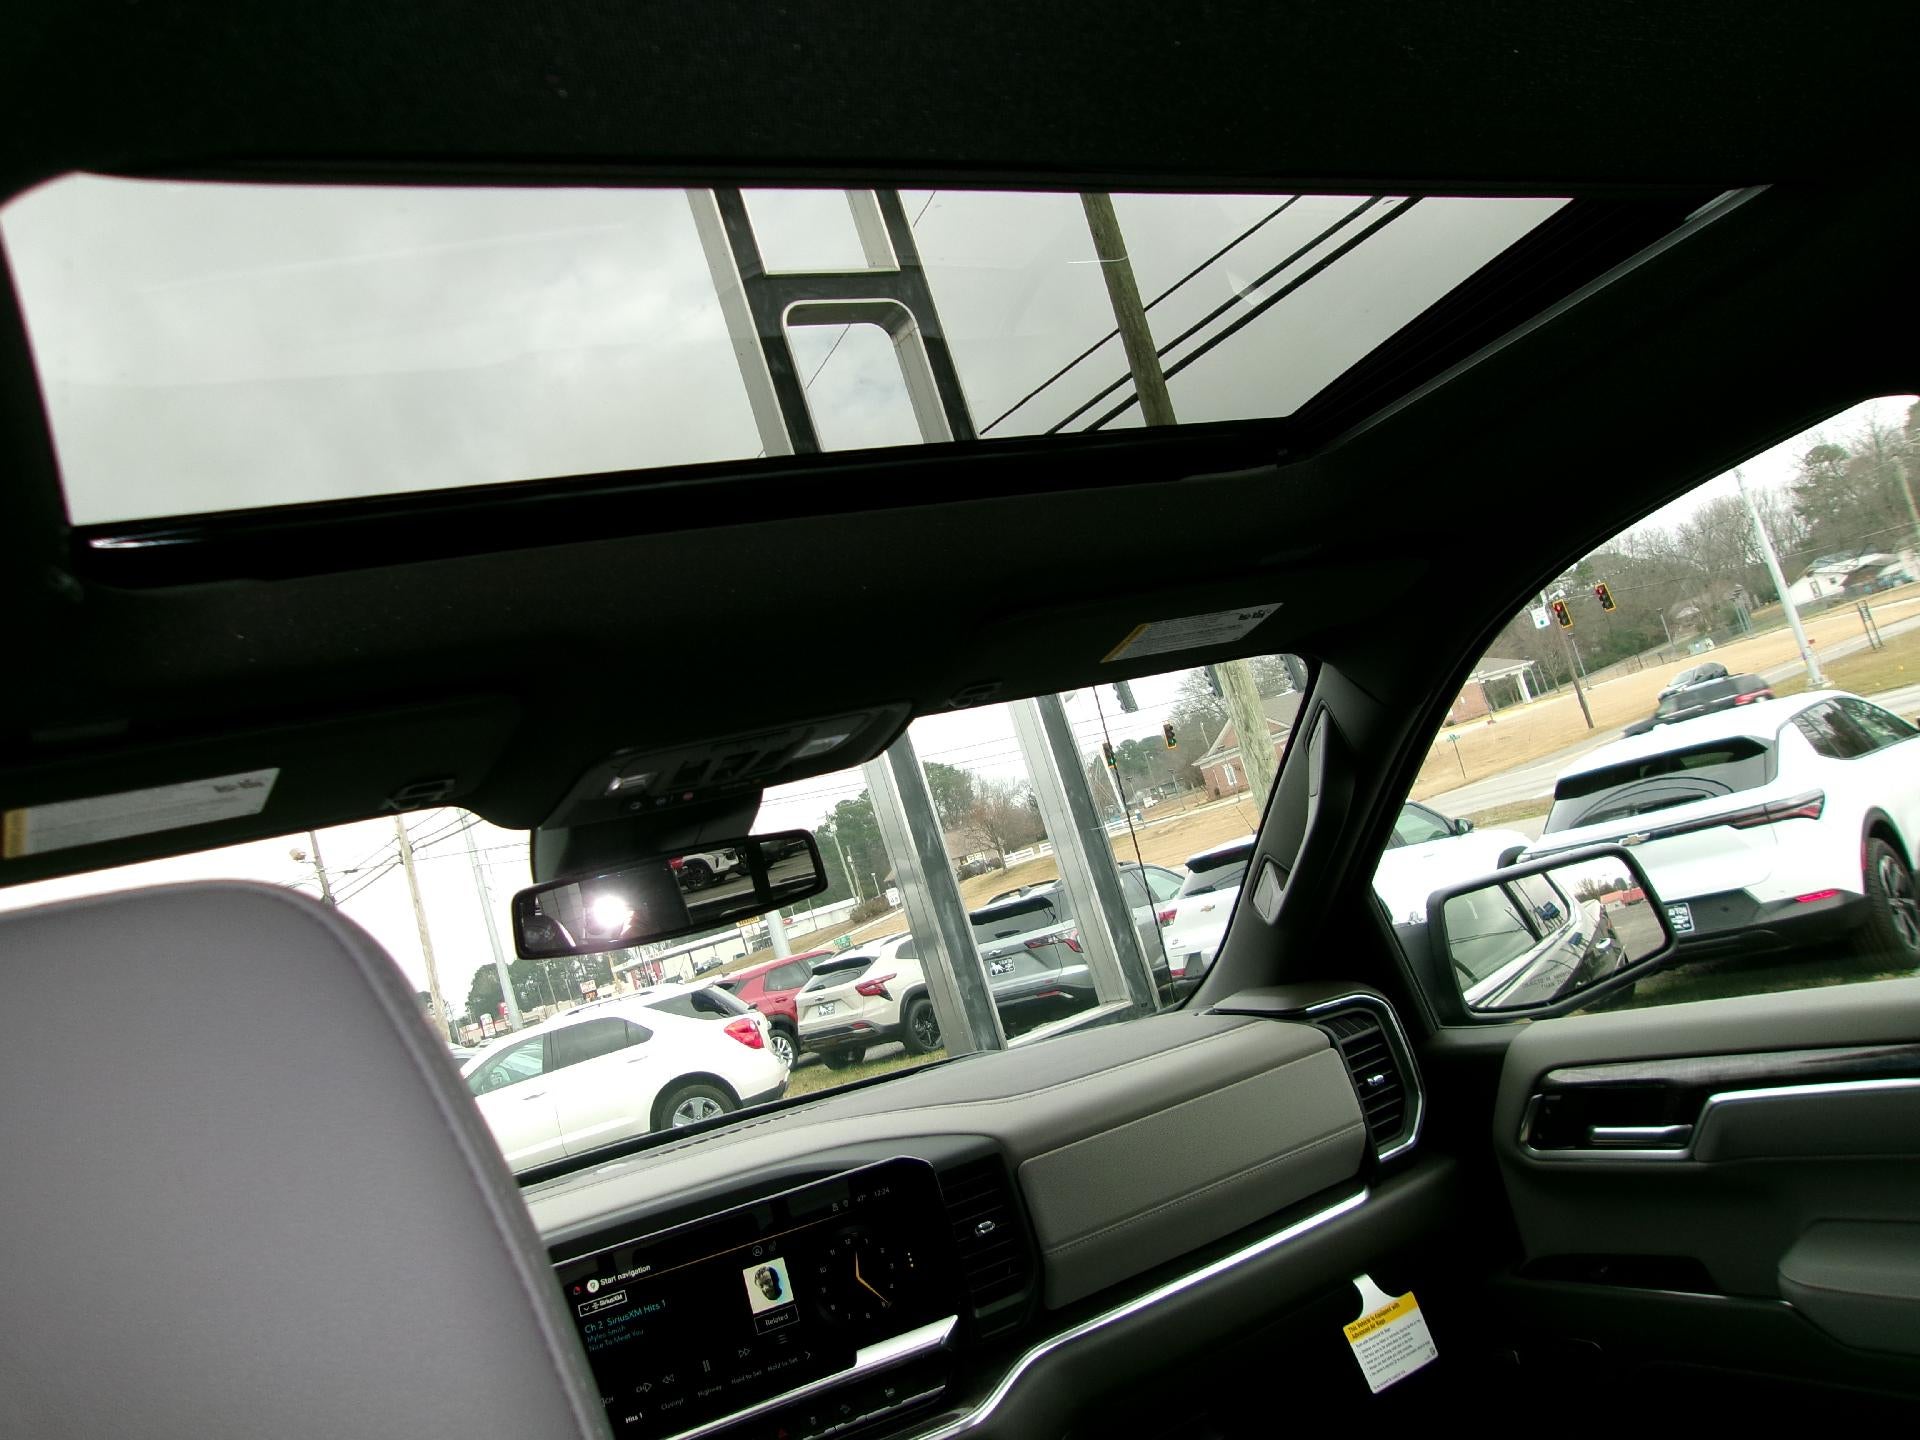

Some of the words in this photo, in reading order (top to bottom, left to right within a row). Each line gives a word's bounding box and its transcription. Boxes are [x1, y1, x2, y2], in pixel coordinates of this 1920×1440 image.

[600, 1275, 617, 1286] Start
[618, 1265, 651, 1280] navigation
[600, 1294, 624, 1306] SiriusXM
[584, 1324, 596, 1334] Ch
[607, 1308, 643, 1326] SiriusXM
[644, 1302, 661, 1314] Hits
[765, 1314, 789, 1326] Related
[625, 1414, 638, 1424] Hits
